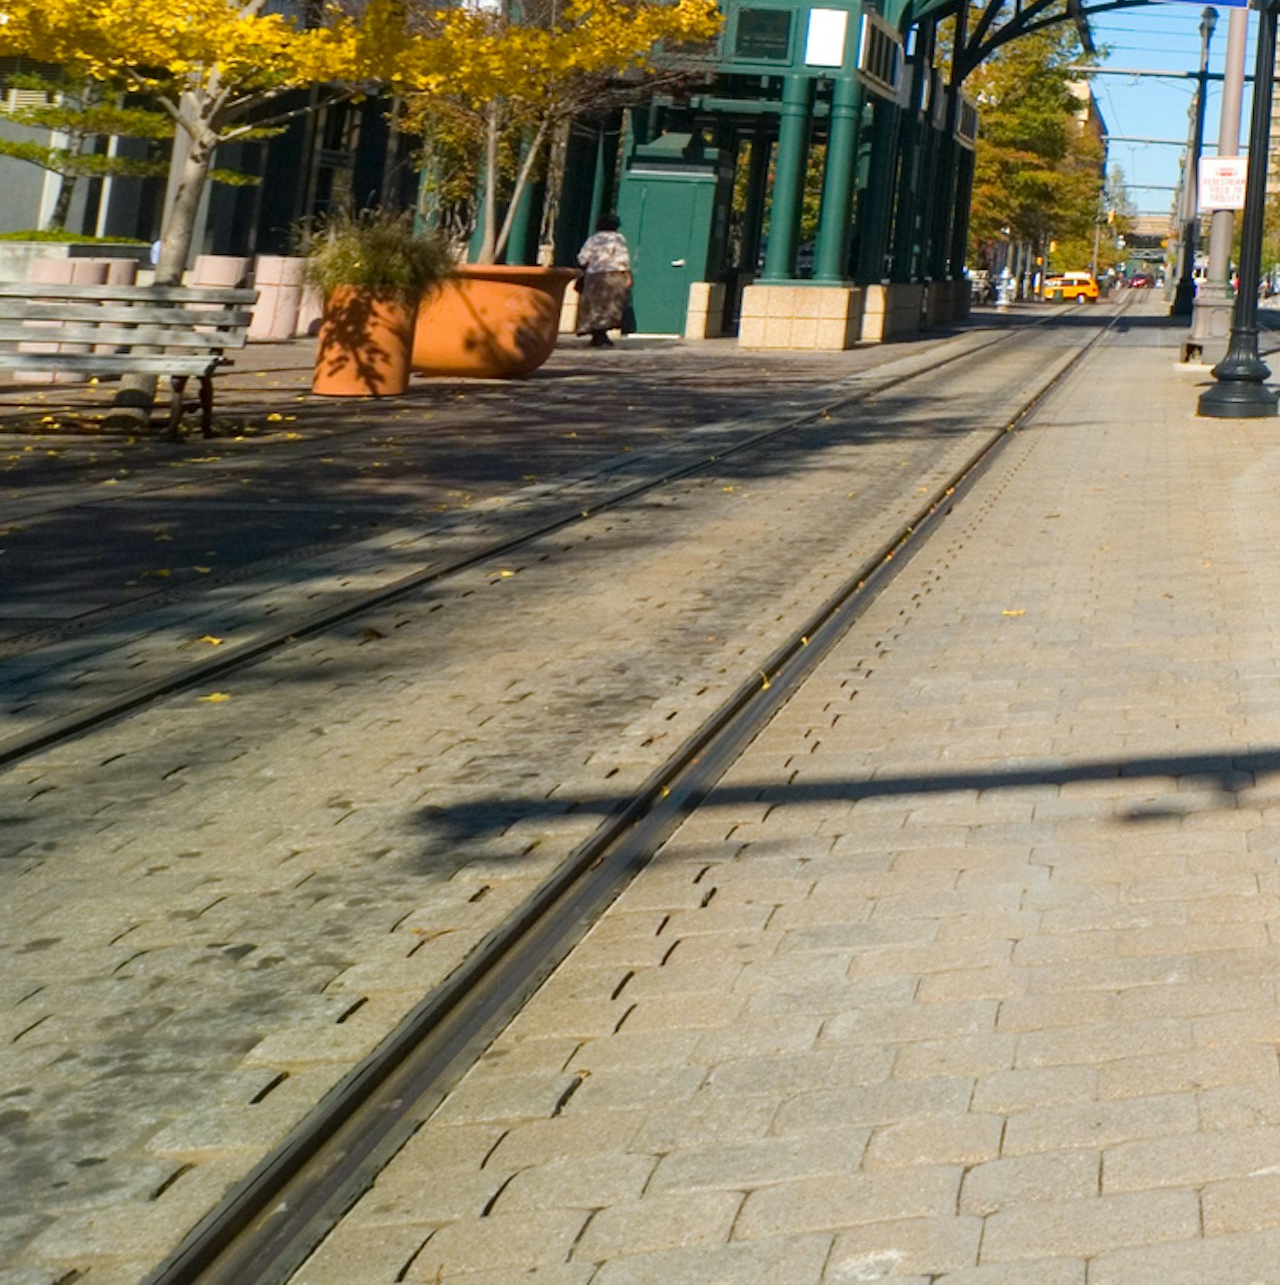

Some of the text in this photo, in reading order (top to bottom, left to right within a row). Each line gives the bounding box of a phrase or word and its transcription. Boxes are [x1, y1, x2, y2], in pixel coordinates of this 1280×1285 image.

[1210, 186, 1243, 194] YIELD TO
[1210, 194, 1241, 202] TROLLEY
